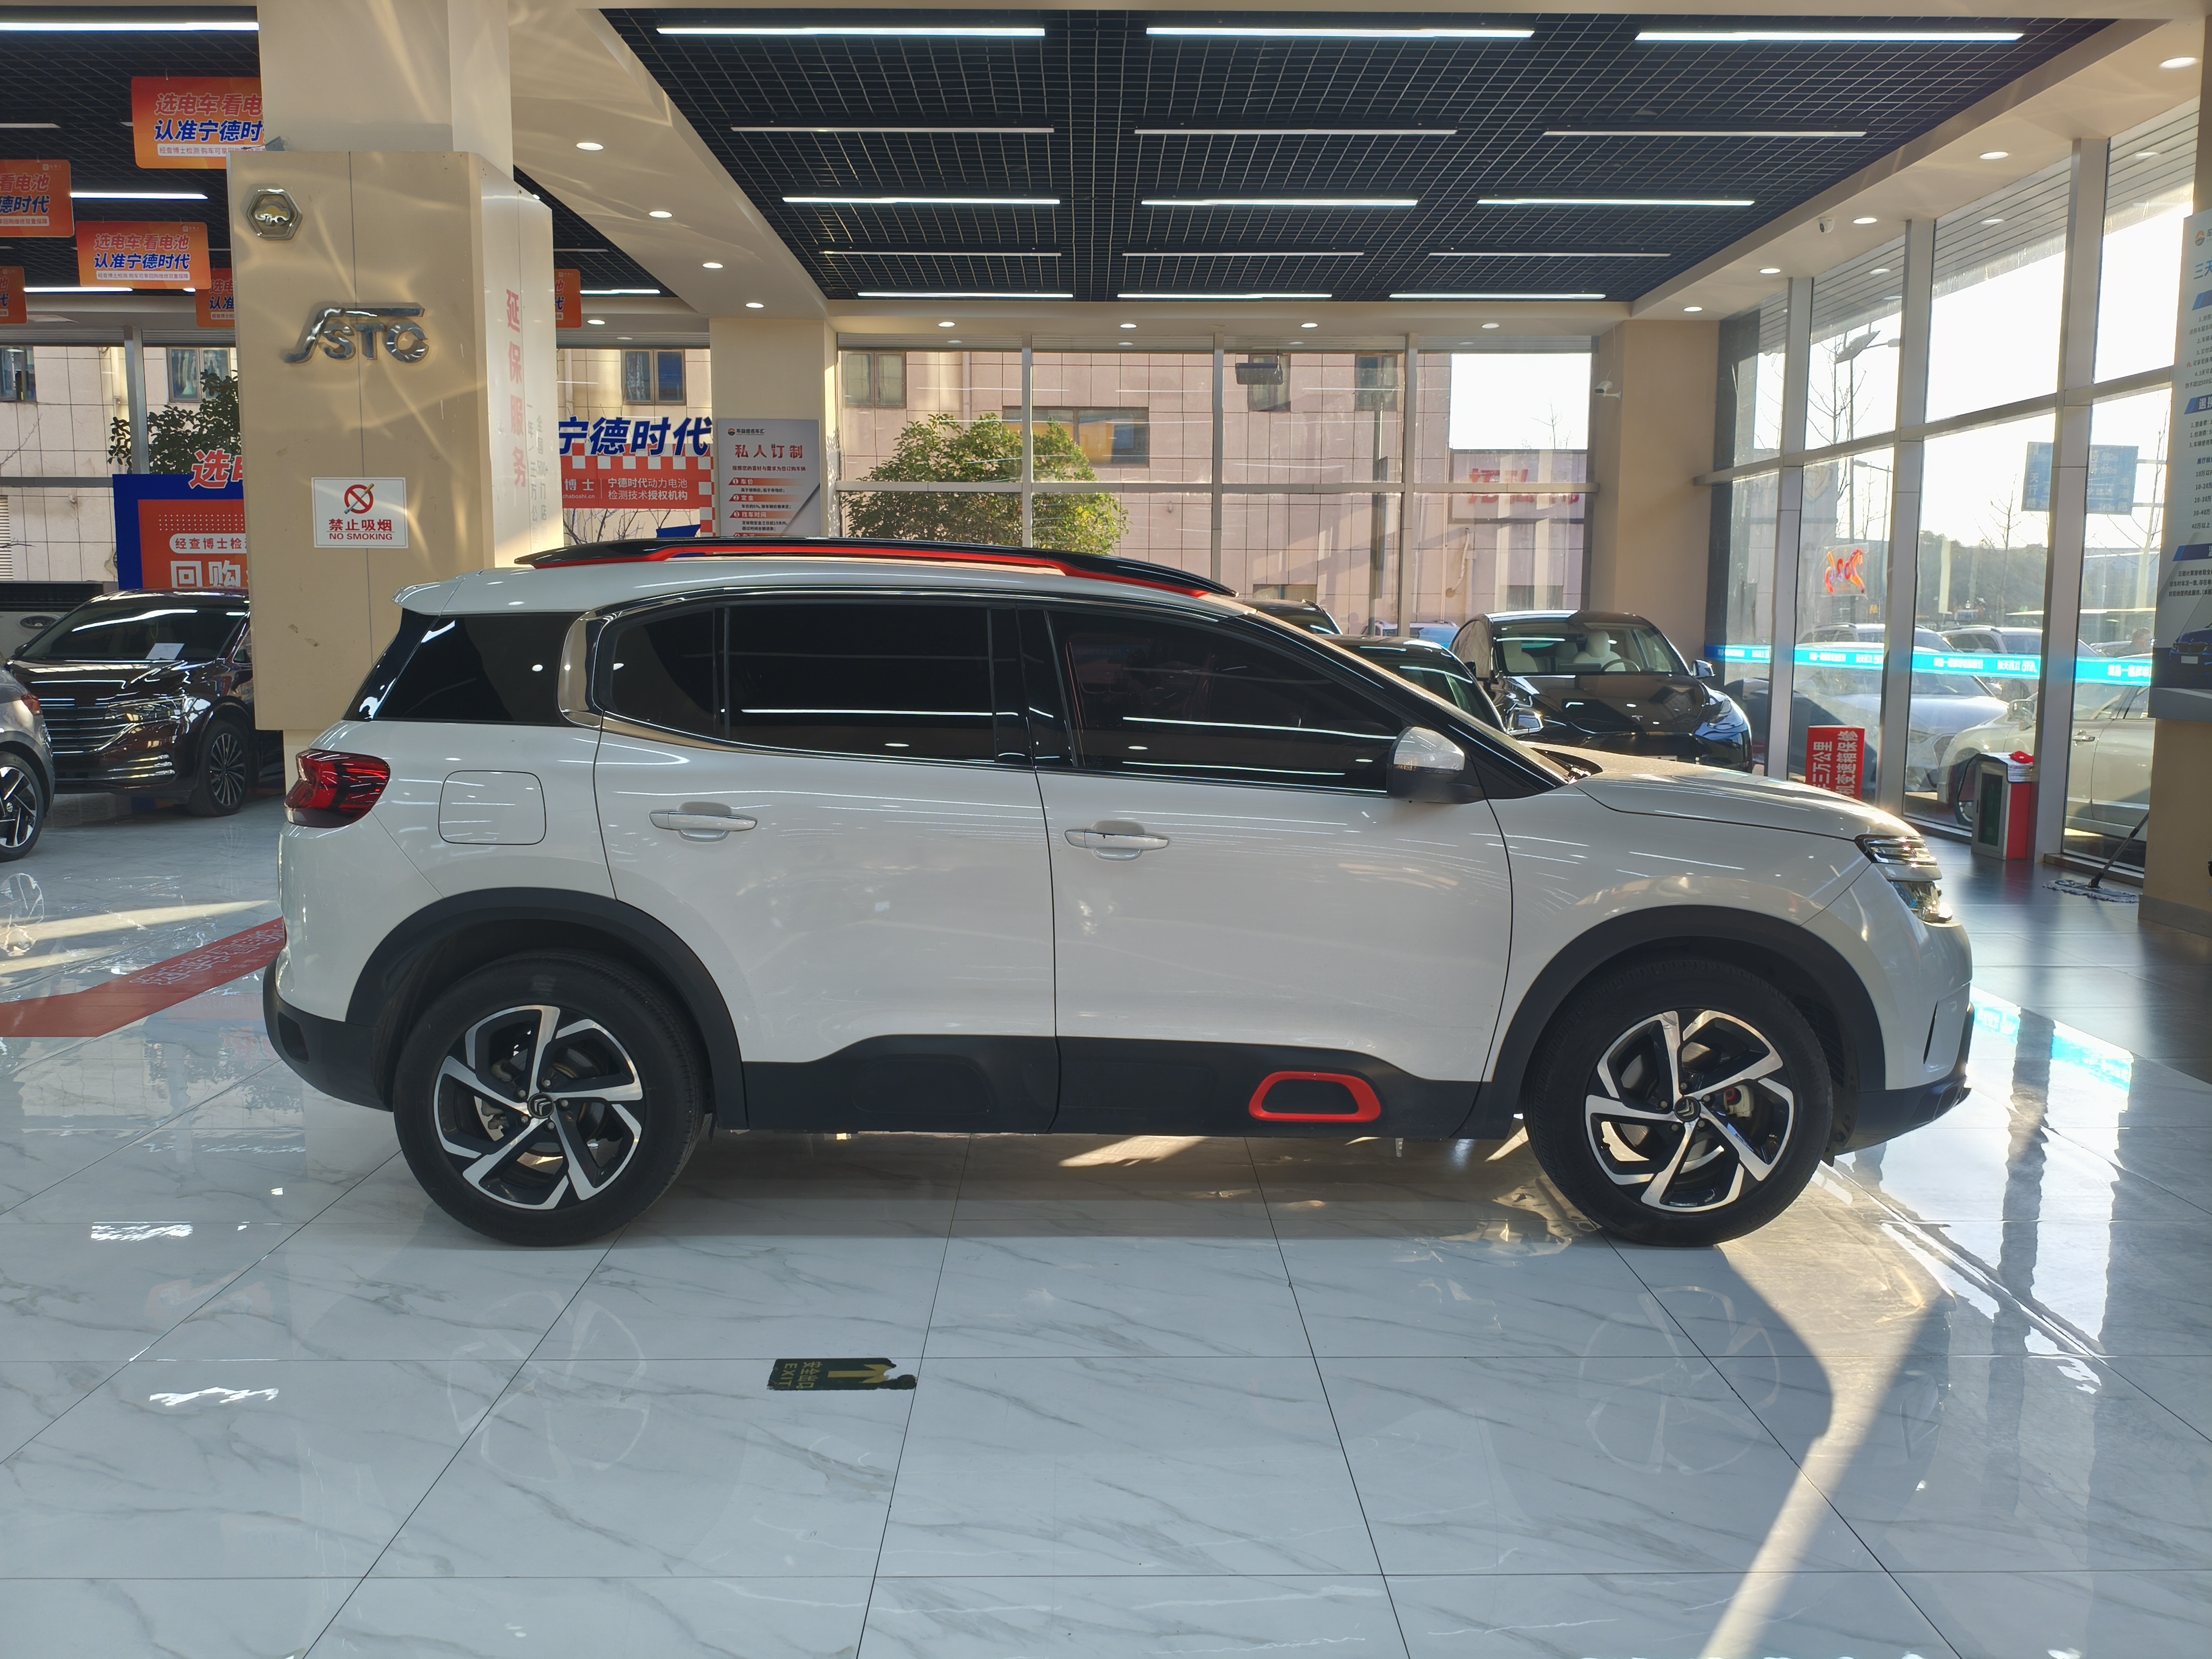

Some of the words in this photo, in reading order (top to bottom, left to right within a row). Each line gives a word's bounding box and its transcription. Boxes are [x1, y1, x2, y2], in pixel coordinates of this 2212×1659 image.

[154, 118, 265, 143] 认准宁德时
[94, 233, 141, 251] 选电车
[143, 234, 190, 251] 看电池
[94, 253, 191, 269] 认准宁德时代
[558, 416, 713, 457] 宁德时代
[735, 444, 803, 459] 私人订制
[608, 478, 688, 488] 宁德时代动力电池
[608, 490, 688, 501] 检测技术授权机构
[328, 518, 393, 532] 禁止吸烟
[174, 537, 247, 550] 经查博士检
[170, 561, 249, 588] 回购
[778, 1363, 798, 1386] EXIT
[796, 1361, 823, 1388] 安全出口
